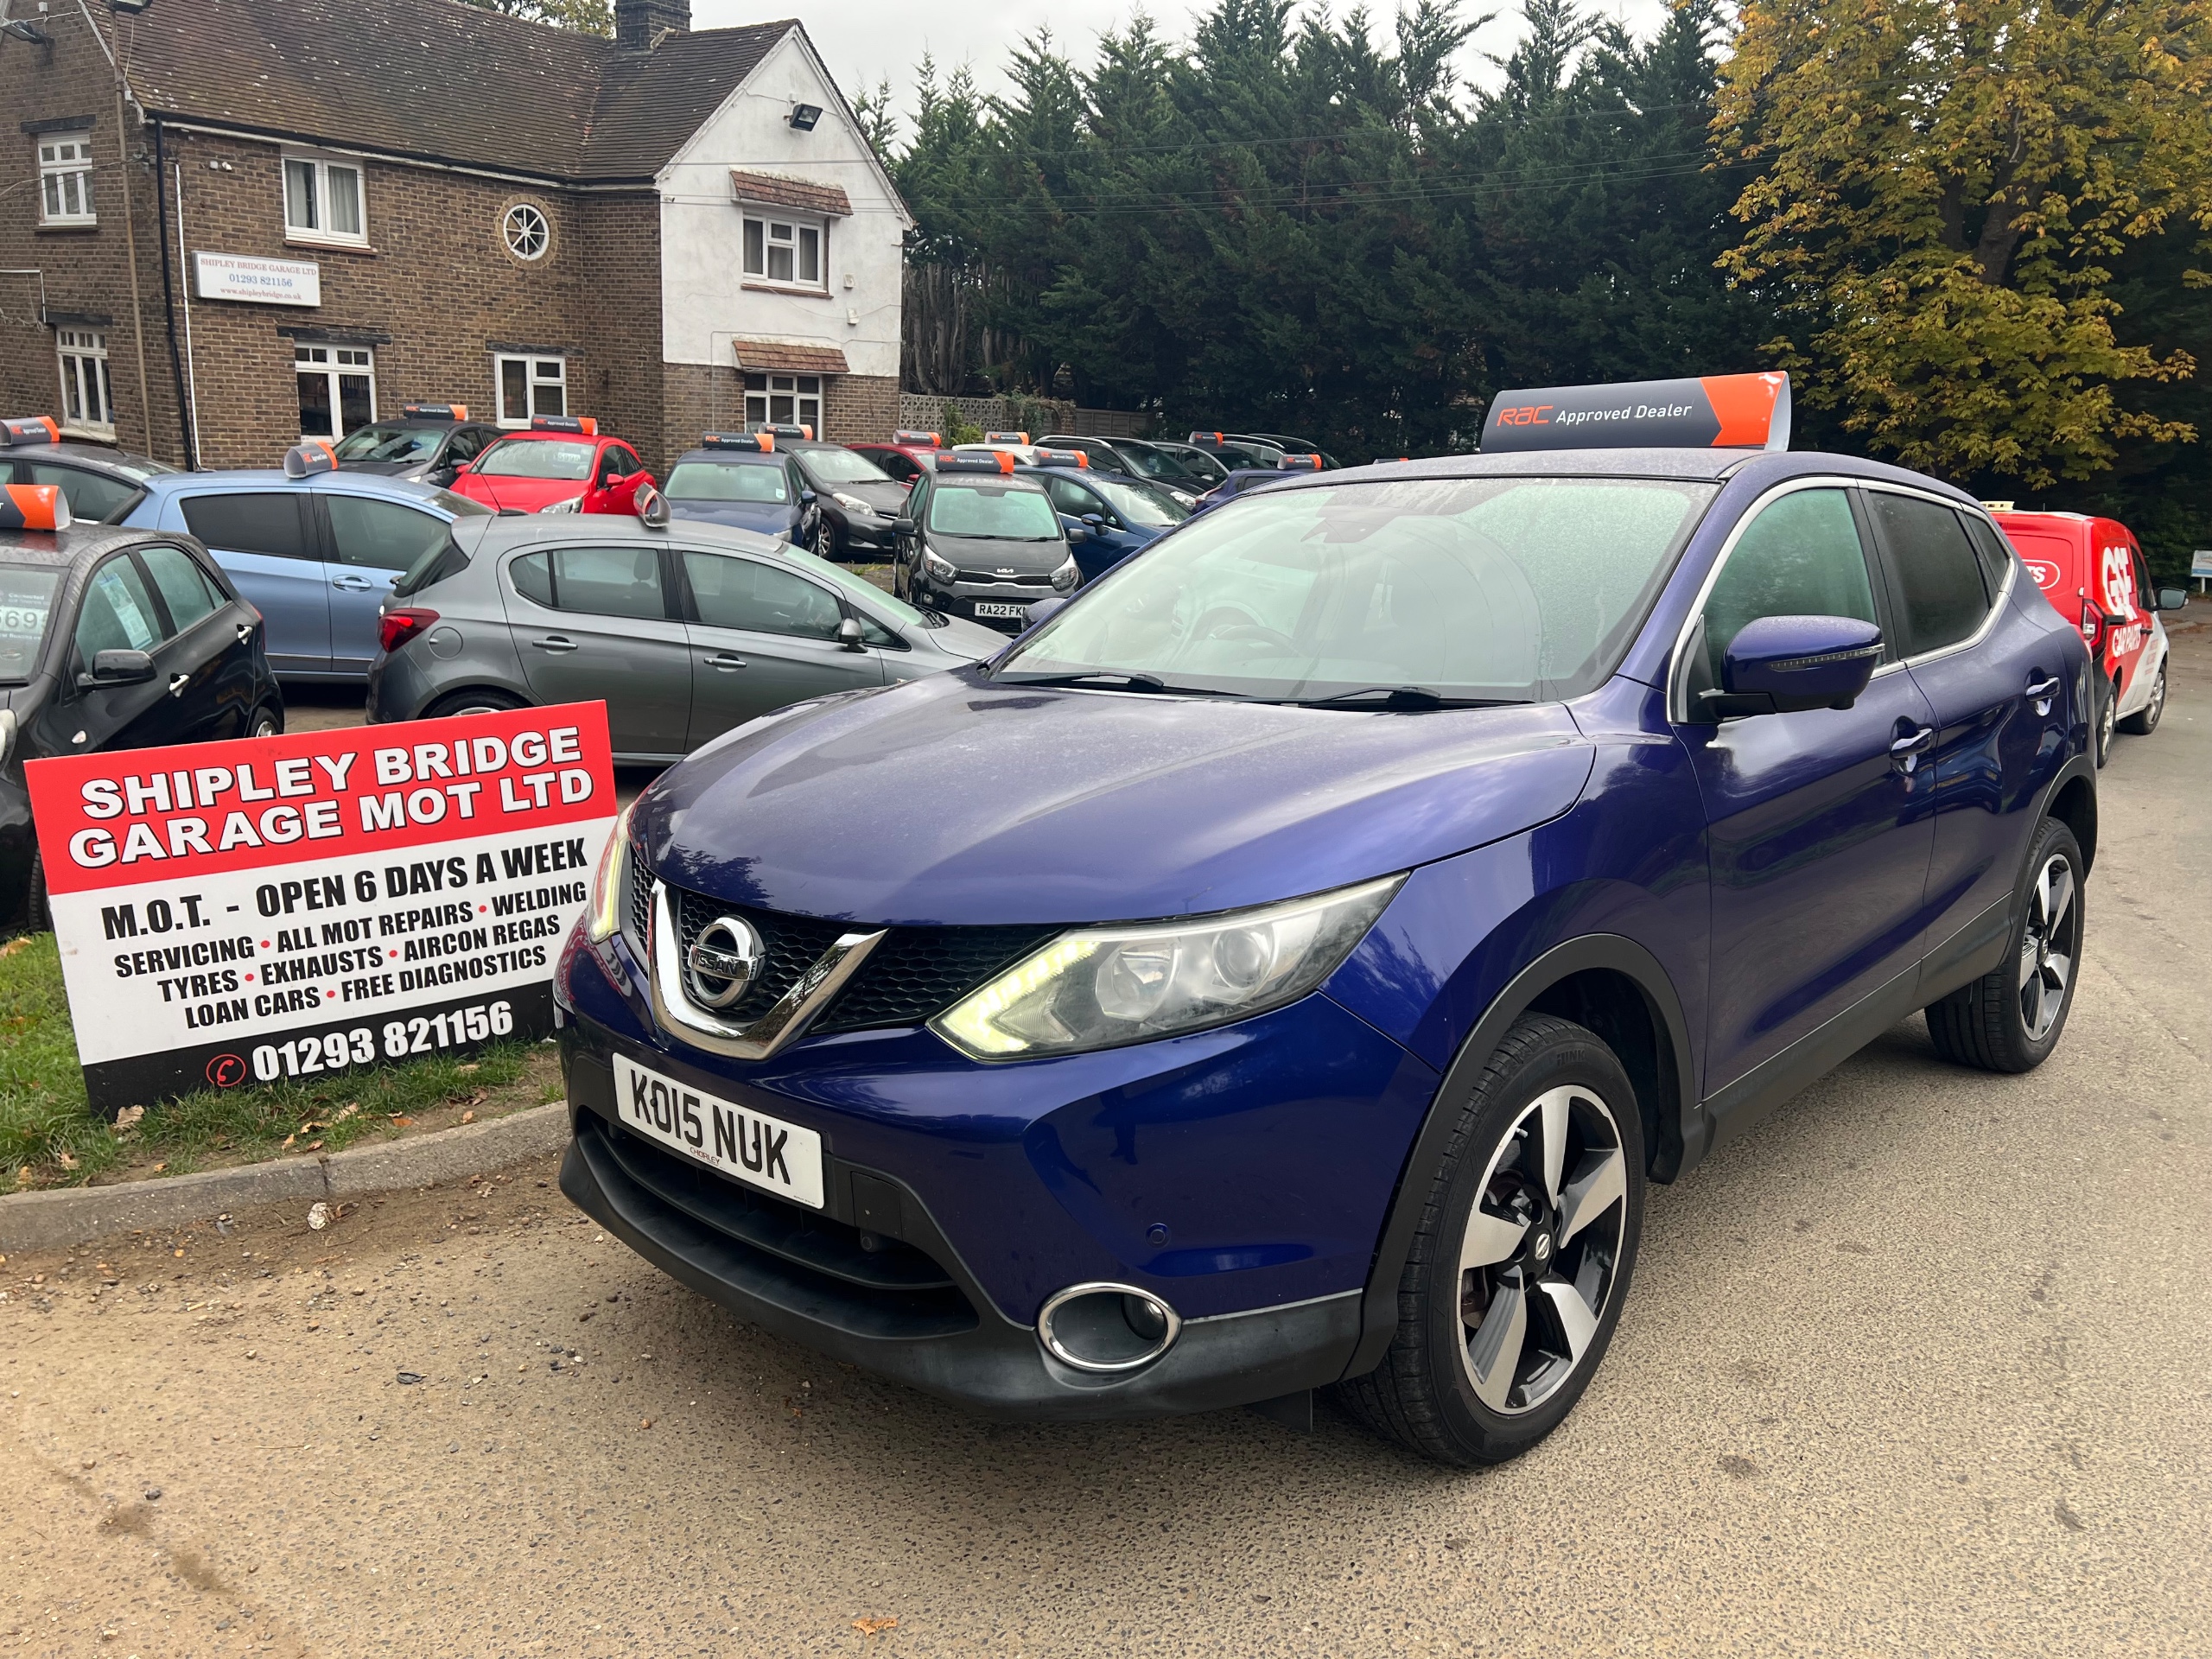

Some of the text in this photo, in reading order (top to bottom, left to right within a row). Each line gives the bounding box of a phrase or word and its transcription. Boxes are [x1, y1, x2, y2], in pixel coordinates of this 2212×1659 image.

[200, 258, 236, 269] SHIPLEY
[238, 262, 267, 271] BRIDGE
[269, 264, 301, 275] GARAGE
[220, 288, 302, 300] www.shipleybridge.co.uk
[229, 273, 293, 287] 01293 821156
[1555, 405, 1632, 426] Approved
[1636, 404, 1694, 418] Dealer
[979, 604, 1007, 615] RA22
[80, 726, 582, 820] SHIPLEY BRIDGE
[68, 767, 594, 868] GARAGE MOT LTD
[101, 894, 211, 940] M.O.T.
[256, 874, 346, 917] OPEN
[354, 870, 378, 903] 6
[385, 856, 468, 899] DAYS
[476, 853, 498, 884] A
[501, 837, 588, 880] WEEK
[114, 881, 587, 978] SERVICING ALL MOT REPAIRS WELDING
[157, 914, 561, 1002] TYRES EXHAUSTS AIRCON REGAS
[691, 948, 741, 976] NISSAN
[185, 945, 547, 1029] LOAN CARS FREE DIAGNOSTICS
[252, 1001, 513, 1081] 01293 821156
[630, 1069, 791, 1185] KO15 NUK
[690, 1147, 721, 1166] CHORLEY
